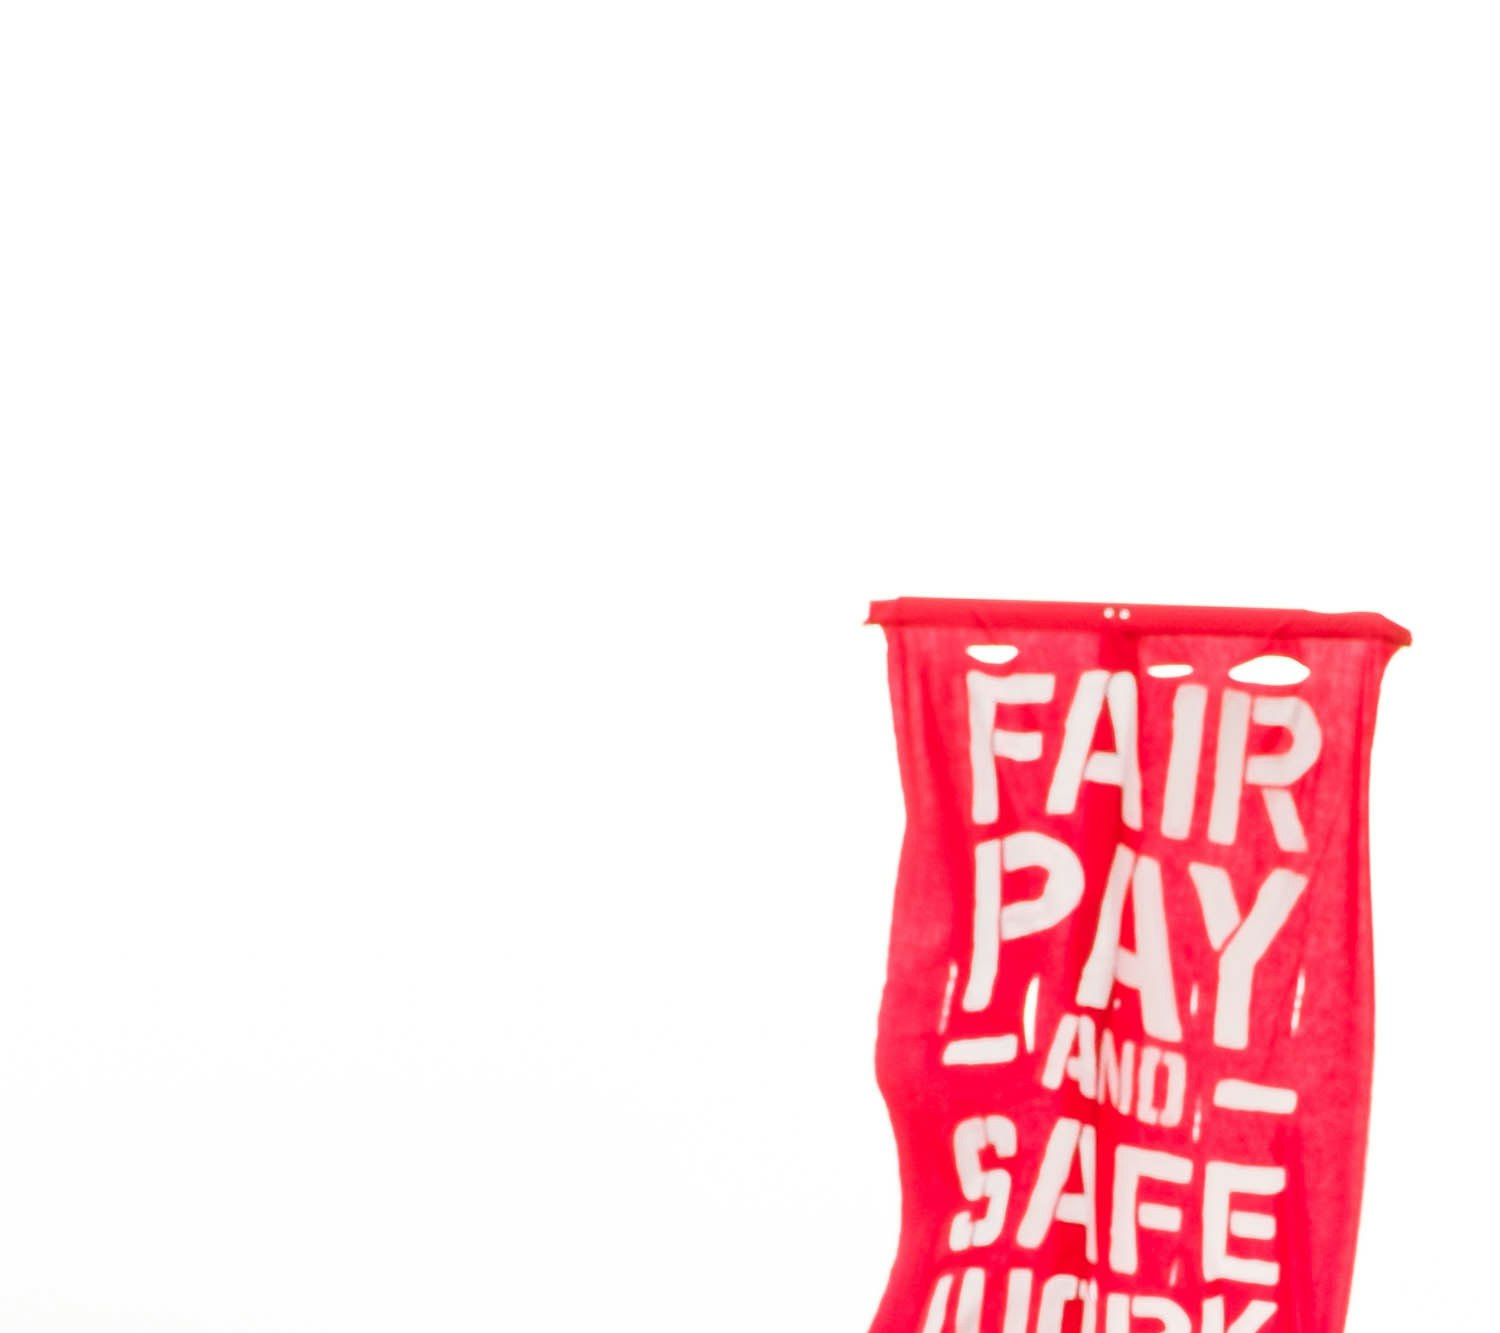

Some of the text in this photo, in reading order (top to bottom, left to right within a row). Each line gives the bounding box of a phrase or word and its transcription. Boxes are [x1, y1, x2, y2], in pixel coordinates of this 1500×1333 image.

[965, 669, 1324, 852] FAIR
[961, 832, 1309, 1050] PAY
[949, 1115, 1285, 1285] SAFE
